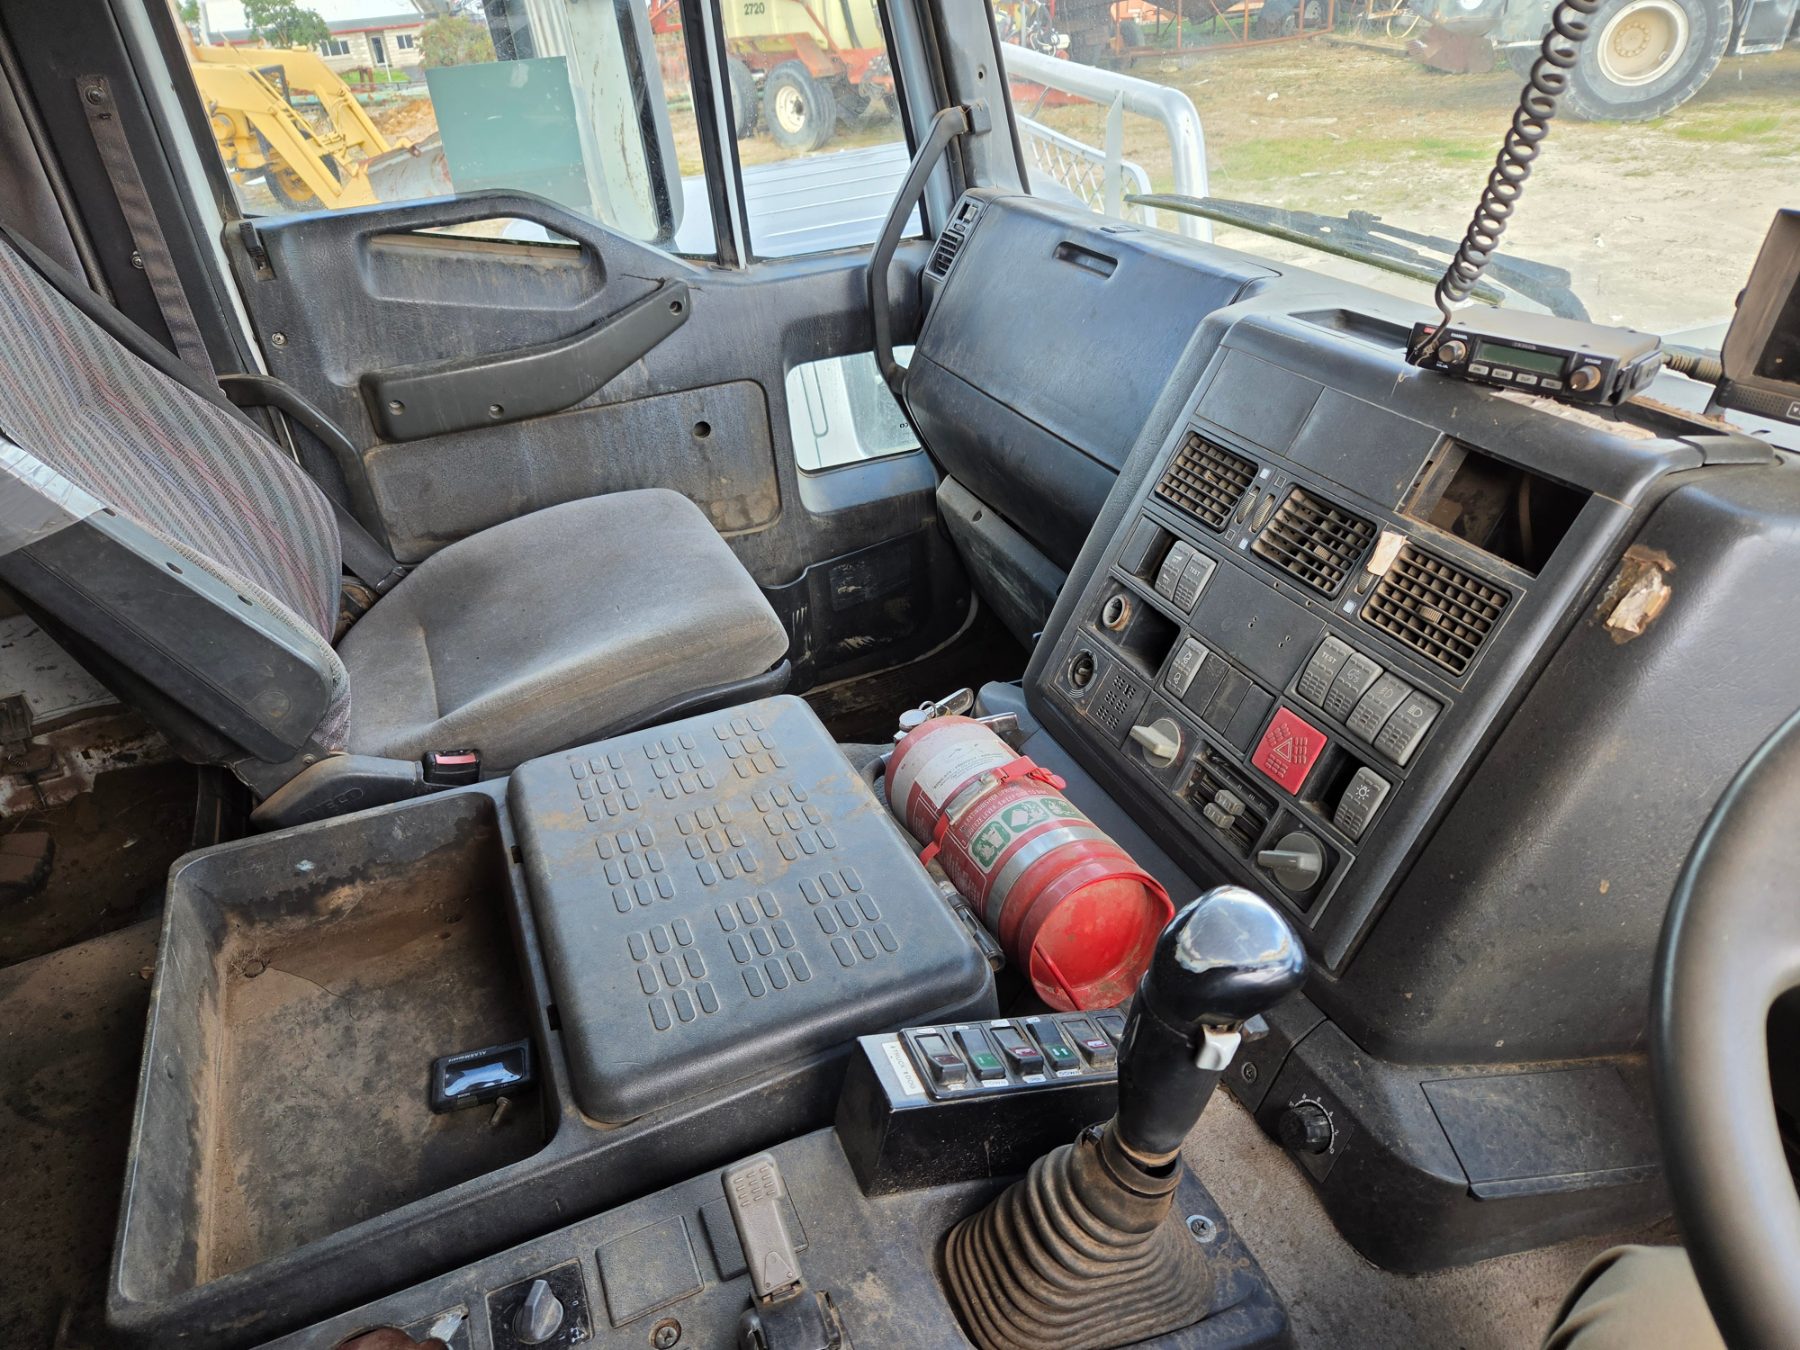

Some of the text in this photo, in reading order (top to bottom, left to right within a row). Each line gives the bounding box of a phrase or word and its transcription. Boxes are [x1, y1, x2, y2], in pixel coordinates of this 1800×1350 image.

[744, 2, 765, 15] 2720
[1189, 566, 1201, 577] TEST
[1321, 651, 1337, 664] TEST
